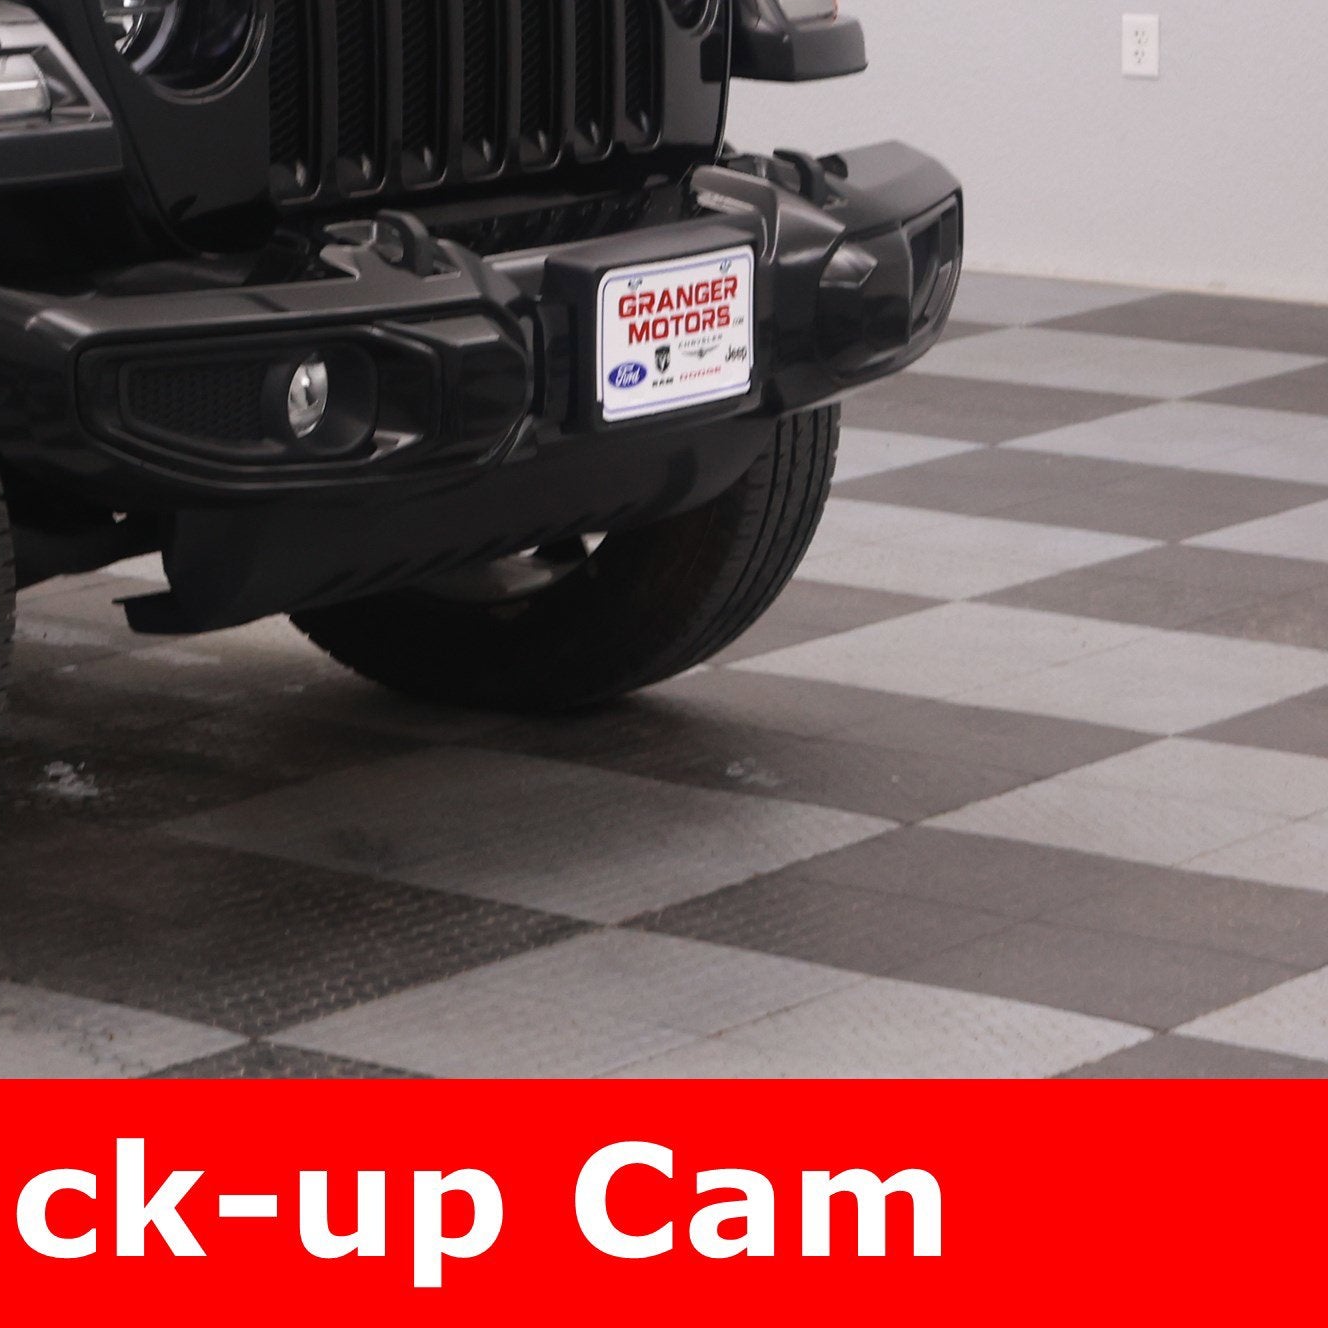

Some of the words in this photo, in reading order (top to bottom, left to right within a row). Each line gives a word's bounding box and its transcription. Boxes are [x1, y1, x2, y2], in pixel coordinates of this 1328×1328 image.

[619, 276, 738, 318] GRANGER
[628, 306, 730, 344] MOTORS
[725, 344, 748, 363] Jeep
[613, 363, 643, 388] Ford
